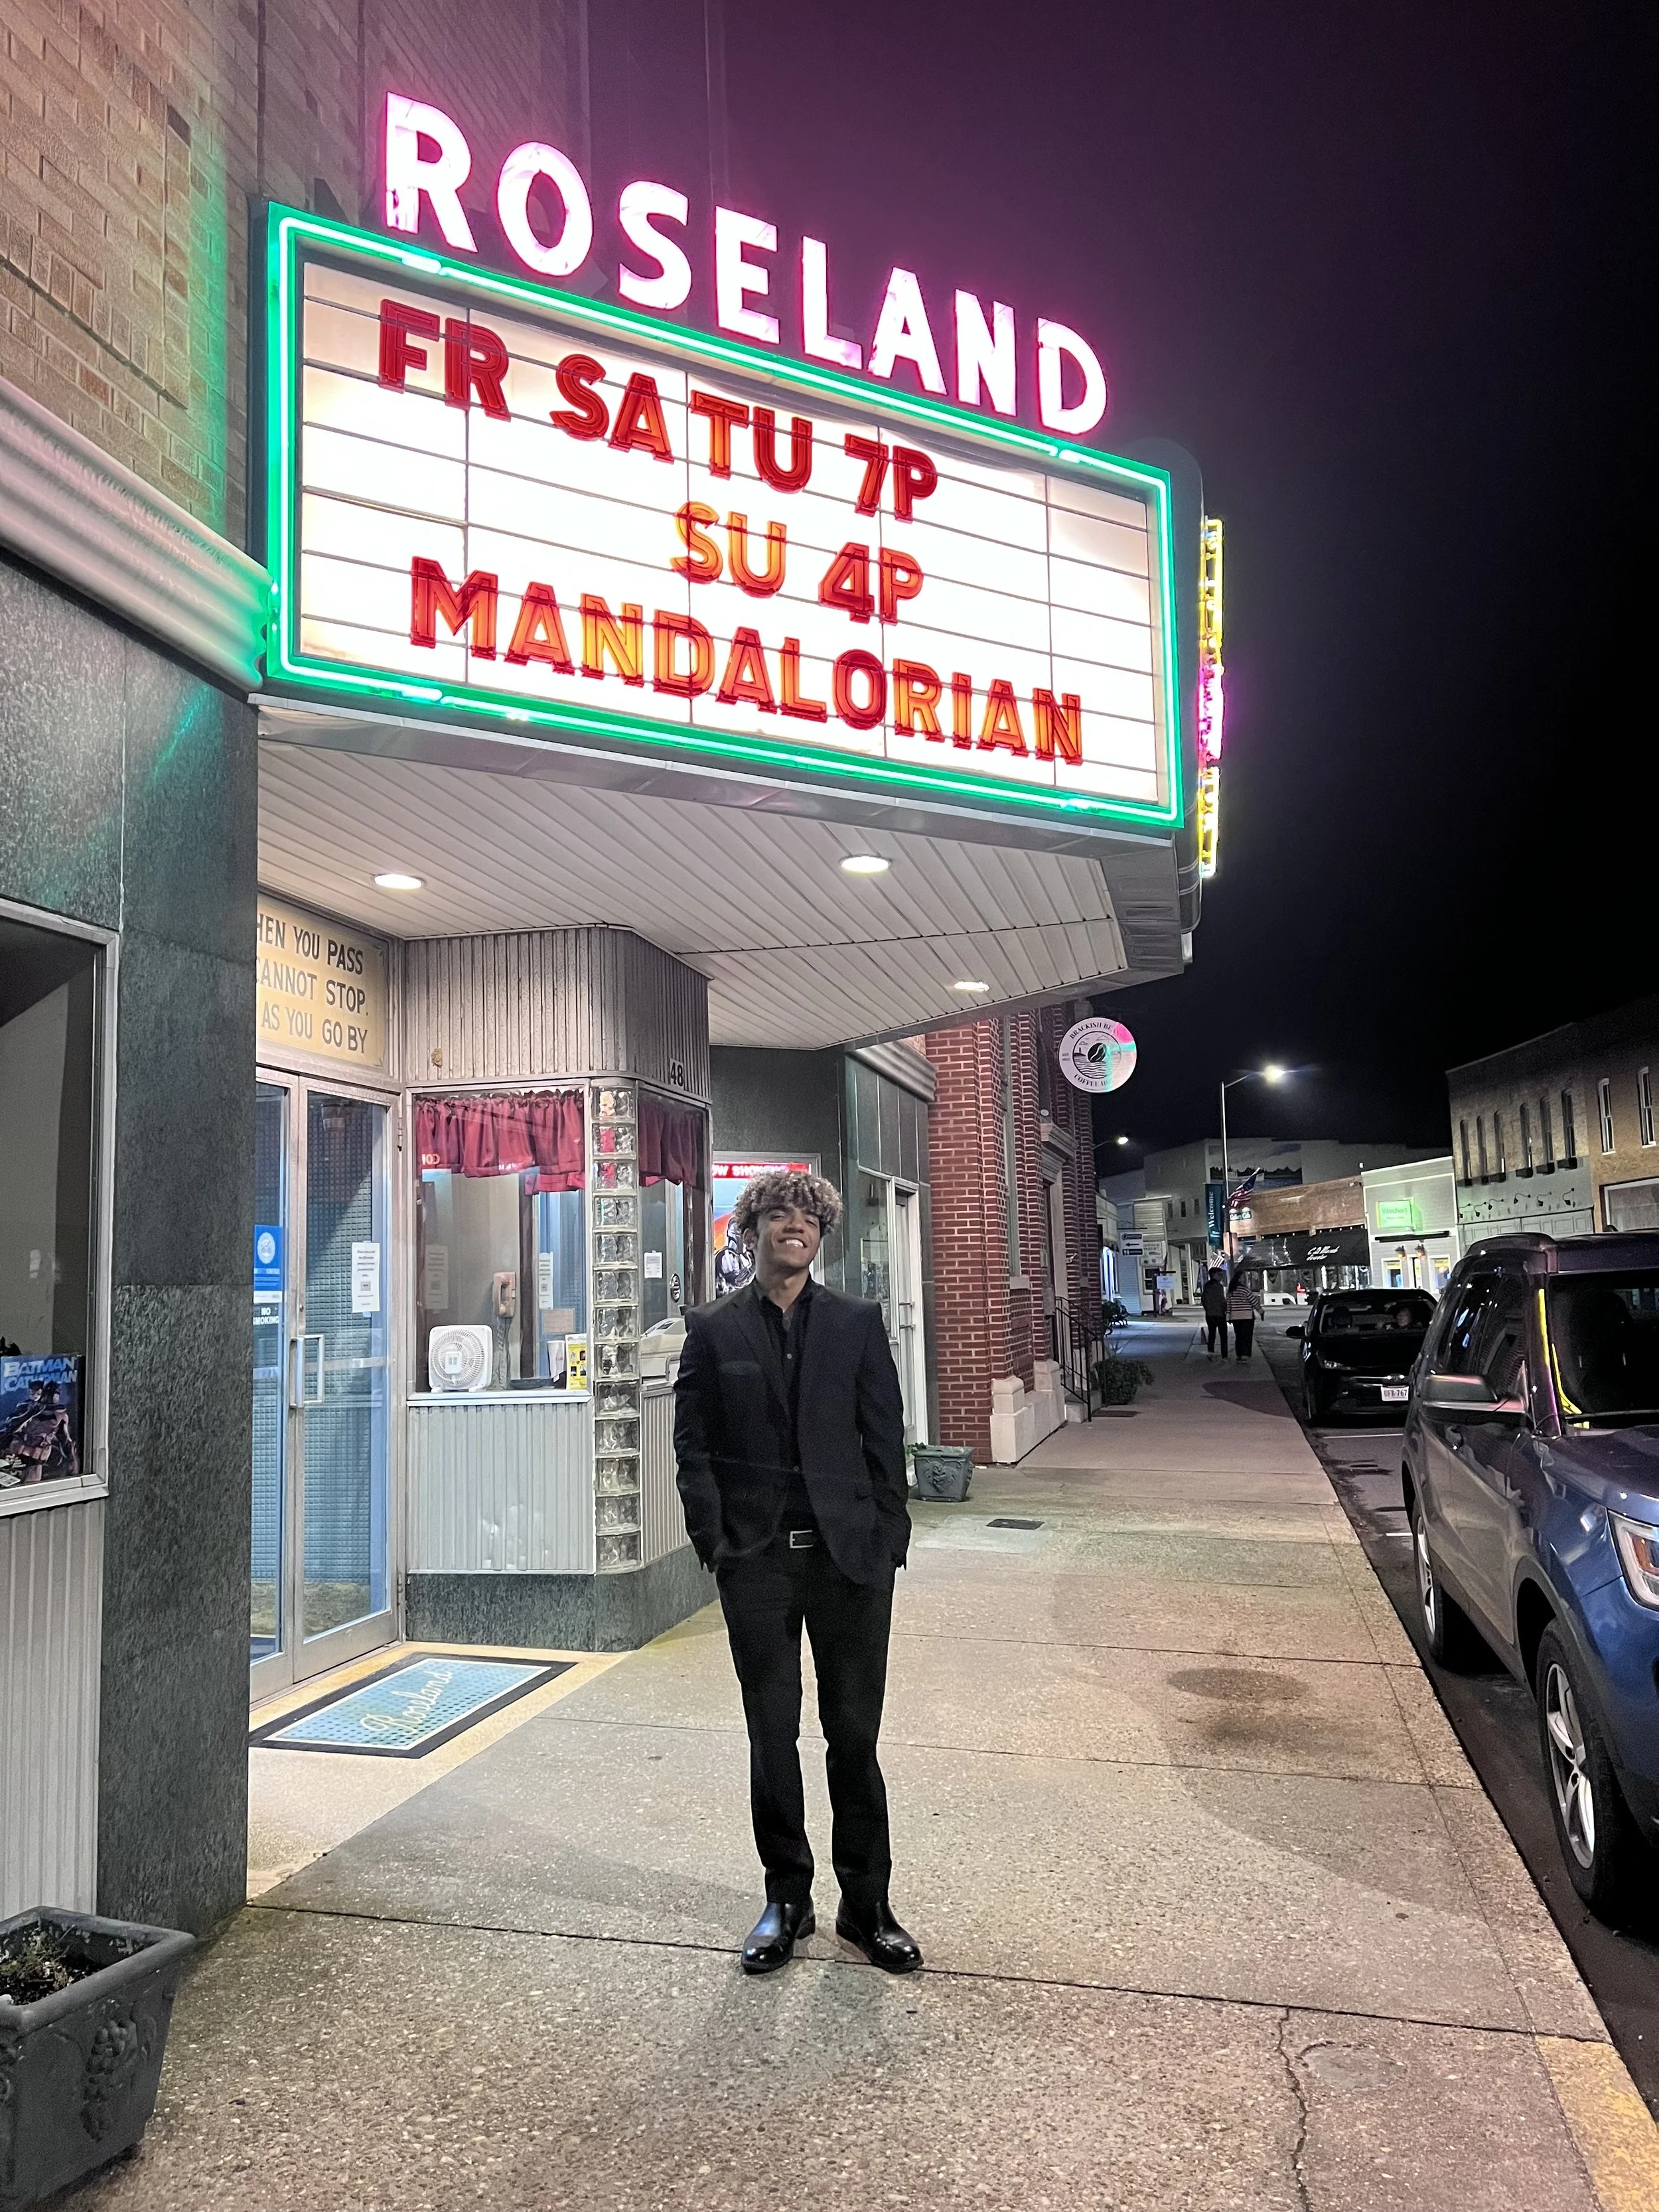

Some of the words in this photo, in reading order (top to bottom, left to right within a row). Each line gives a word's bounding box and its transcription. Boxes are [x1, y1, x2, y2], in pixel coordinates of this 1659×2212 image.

[386, 92, 1108, 435] ROSELAND
[379, 299, 511, 421] FR
[844, 433, 938, 524] 7P
[670, 500, 787, 599] SU
[818, 541, 924, 626] 4P
[410, 556, 1083, 766] MANDALORIAN
[293, 926, 320, 960] YOU
[327, 939, 363, 976] PASS
[261, 1001, 280, 1031] AS
[285, 1006, 313, 1040] YOU
[322, 1019, 343, 1047] GO
[348, 1024, 368, 1054] BY
[1070, 1022, 1103, 1039] BRACKISH
[670, 1062, 684, 1086] 48
[1074, 1074, 1099, 1087] COFFEE
[261, 1307, 271, 1316] NO
[4, 1357, 76, 1378] BATMAN
[360, 1670, 453, 1735] Roseland
